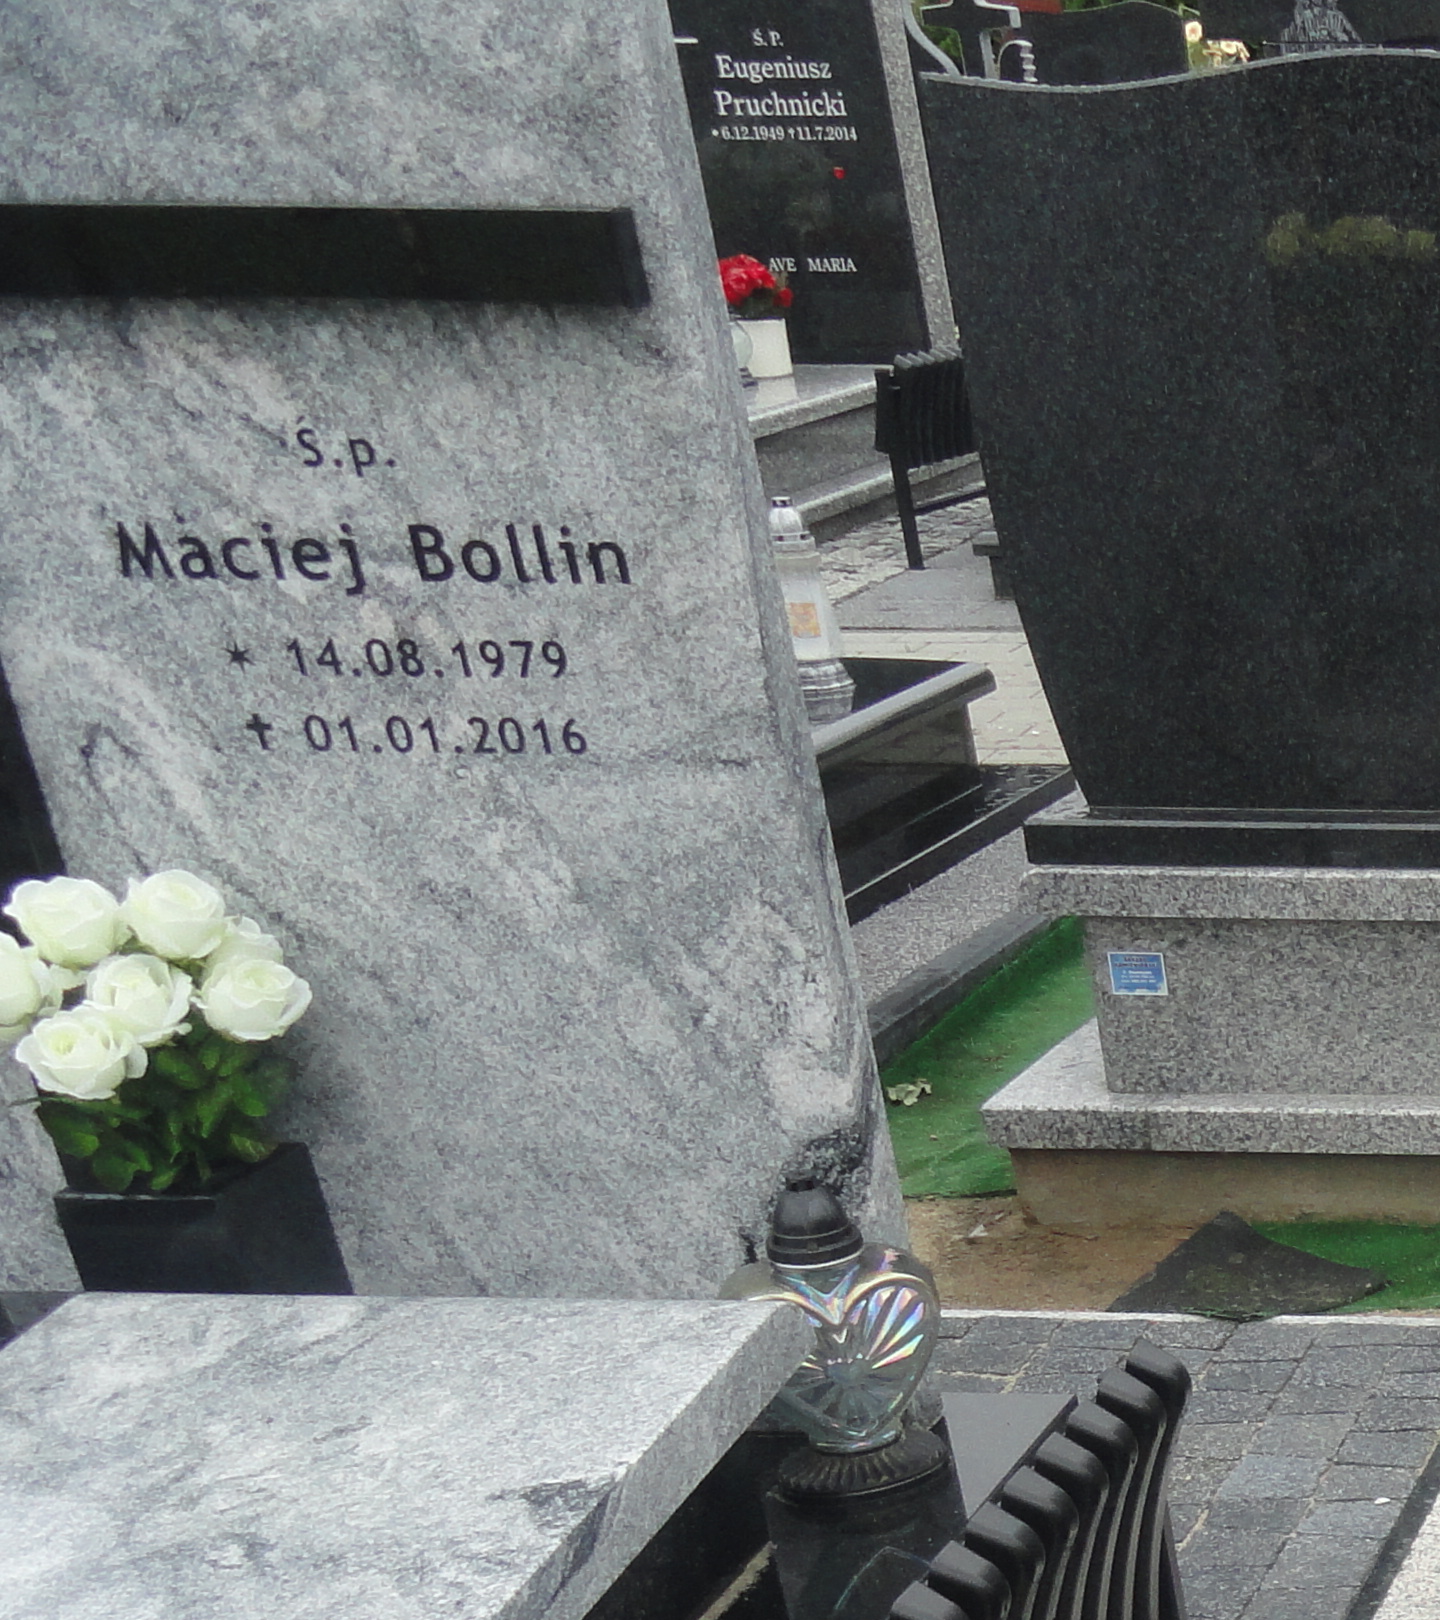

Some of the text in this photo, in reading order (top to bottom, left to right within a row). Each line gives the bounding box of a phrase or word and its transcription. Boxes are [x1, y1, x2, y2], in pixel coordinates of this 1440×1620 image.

[715, 54, 832, 84] Eugeniusz
[713, 89, 847, 116] Pruchnicki
[722, 126, 858, 141] 6.12.1949 11.7.2014
[769, 257, 857, 272] AVE MARIA
[116, 520, 632, 594] Maciej Bollin
[288, 637, 568, 680] 14.08.1979
[304, 715, 588, 757] 01.01.2016
